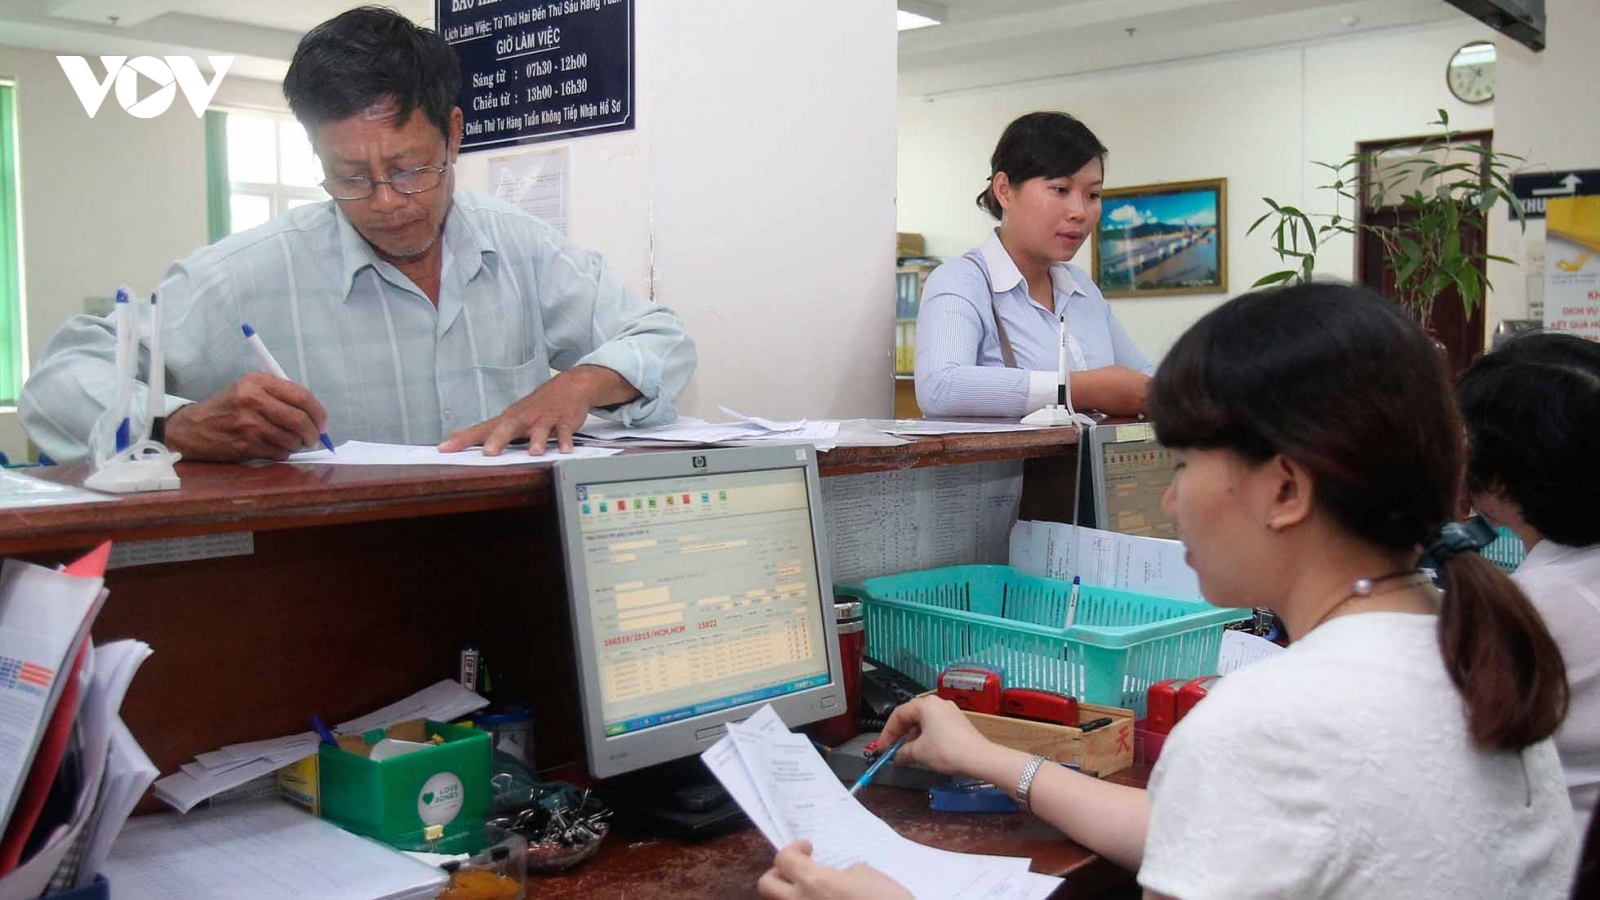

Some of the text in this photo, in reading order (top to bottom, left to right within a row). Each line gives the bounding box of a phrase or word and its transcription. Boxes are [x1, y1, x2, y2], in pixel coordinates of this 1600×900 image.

[444, 27, 458, 42] Lịch
[460, 23, 474, 38] Làm
[493, 16, 504, 30] Từ
[504, 12, 518, 27] Thứ
[519, 9, 531, 24] Hai
[532, 5, 546, 21] Đến
[548, 2, 563, 17] Thứ
[564, 0, 578, 14] Sáu
[496, 26, 560, 55] GIỜ LÀM VIỆC
[473, 72, 494, 88] Sáng
[496, 69, 506, 83] từ
[526, 60, 552, 78] 07h30
[560, 53, 588, 71] 12h00
[473, 92, 498, 111] Chiều
[500, 92, 511, 106] từ
[526, 85, 552, 102] 13h00
[560, 79, 588, 96] 16h30
[484, 118, 496, 132] Thứ
[496, 118, 505, 130] Tư
[506, 115, 522, 130] Hàng
[523, 110, 539, 126] Tuần
[541, 110, 561, 124] Không
[563, 104, 577, 122] Tiếp
[580, 103, 597, 119] Nhận
[599, 98, 609, 115] Hồ
[611, 99, 621, 113] Sơ
[439, 782, 458, 795] LOVE
